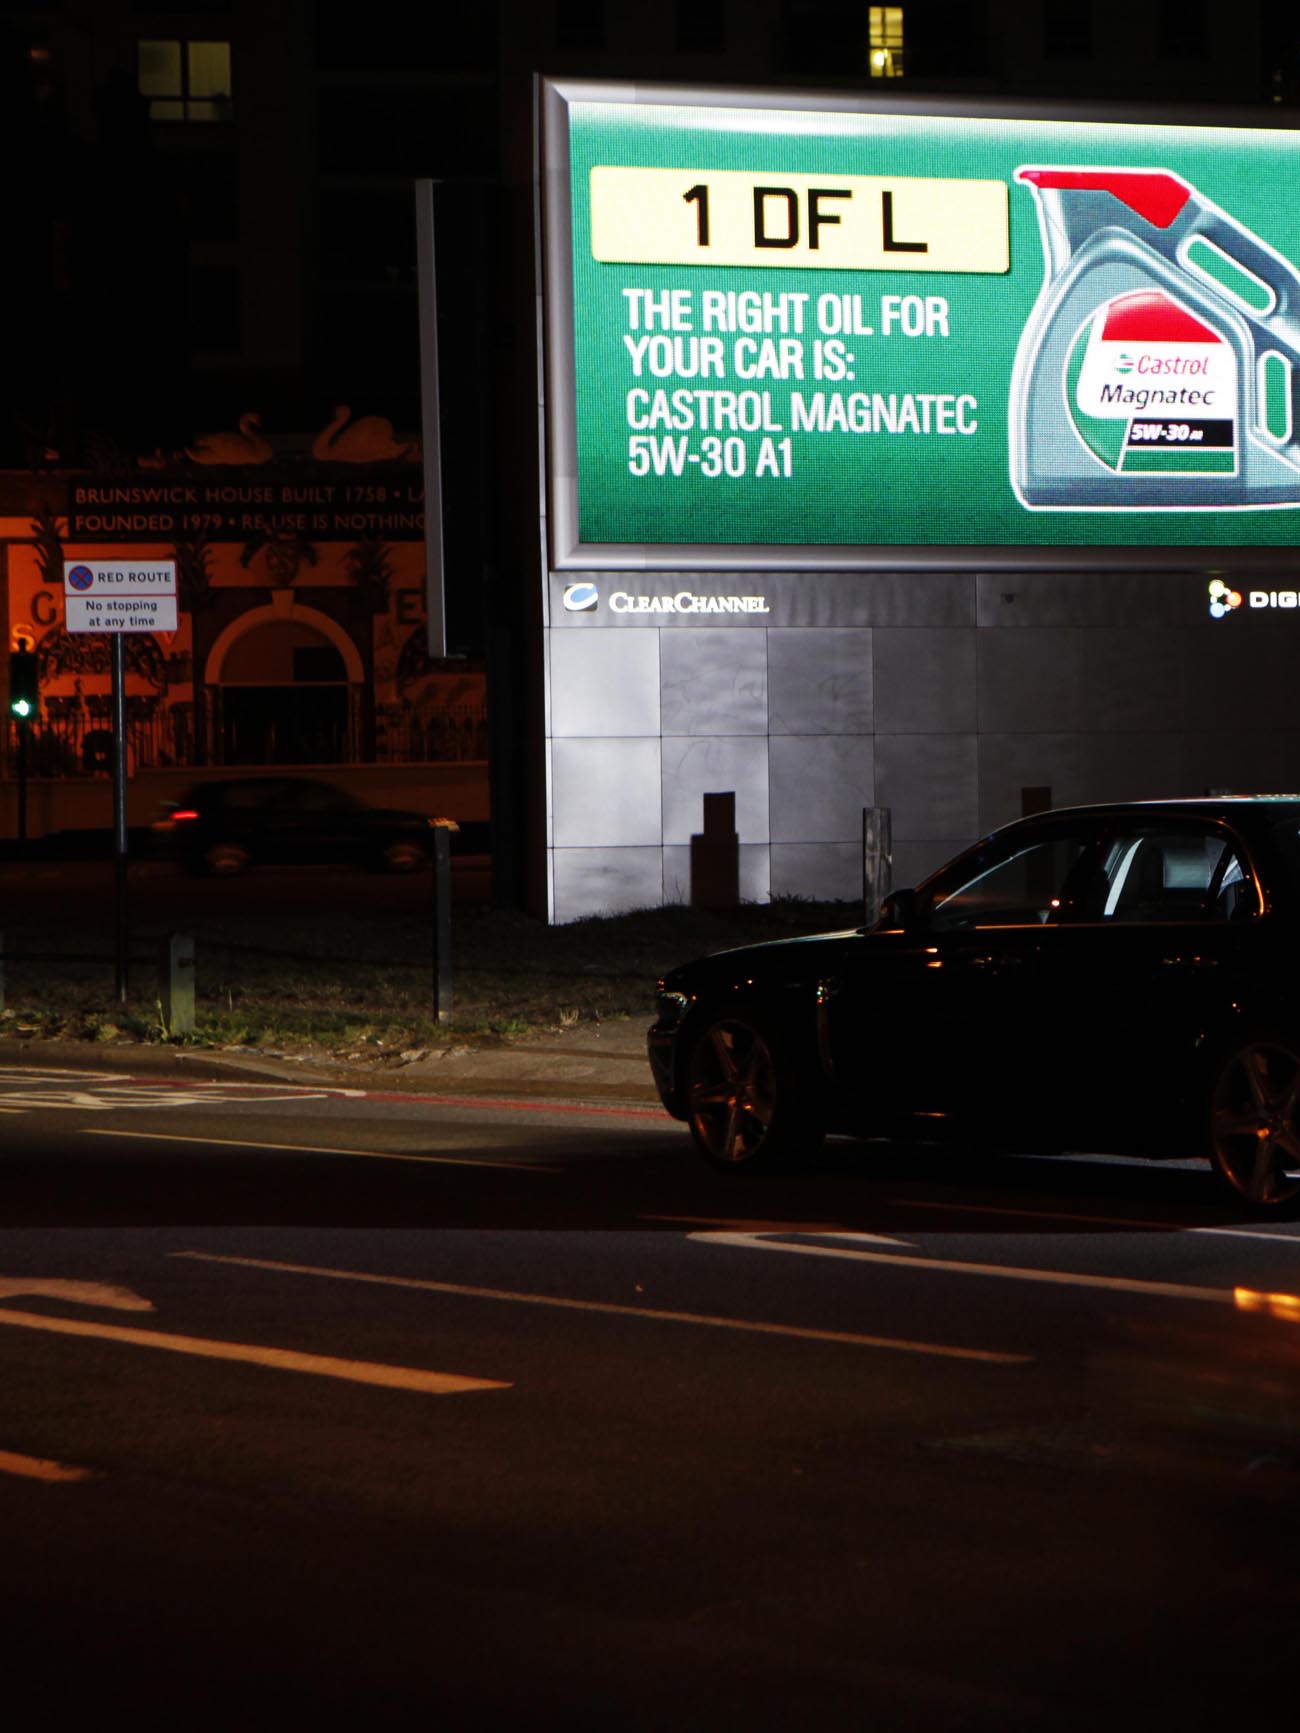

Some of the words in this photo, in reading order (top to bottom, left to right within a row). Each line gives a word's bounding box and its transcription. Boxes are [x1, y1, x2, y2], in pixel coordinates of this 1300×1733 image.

[682, 184, 709, 247] 1
[623, 288, 693, 331] THE
[702, 291, 808, 333] RIGHT
[818, 293, 873, 335] OIL
[882, 296, 949, 337] FOR
[623, 335, 724, 378] YOUR
[734, 338, 803, 379] CAR
[814, 340, 855, 380] IS:
[1137, 355, 1209, 375] Castrol
[1100, 384, 1216, 410] Magnatec
[626, 389, 781, 431] CASTROL
[791, 392, 978, 435] MAGNATEC
[1130, 424, 1190, 441] 5W-30
[628, 435, 746, 477] 5W-30
[755, 437, 793, 477] A1
[75, 487, 199, 504] BRUNSWICK
[205, 487, 274, 503] HOUSE
[281, 487, 336, 503] BUILT
[344, 487, 388, 503] 1758
[75, 513, 174, 531] FOUNDED
[182, 513, 223, 530] 1979
[313, 513, 328, 529] IS
[98, 572, 124, 583] RED
[129, 572, 172, 583] ROUTE
[86, 601, 103, 612] No
[107, 600, 158, 613] stopping
[89, 617, 101, 627] at
[105, 617, 125, 629] any
[129, 616, 155, 627] time
